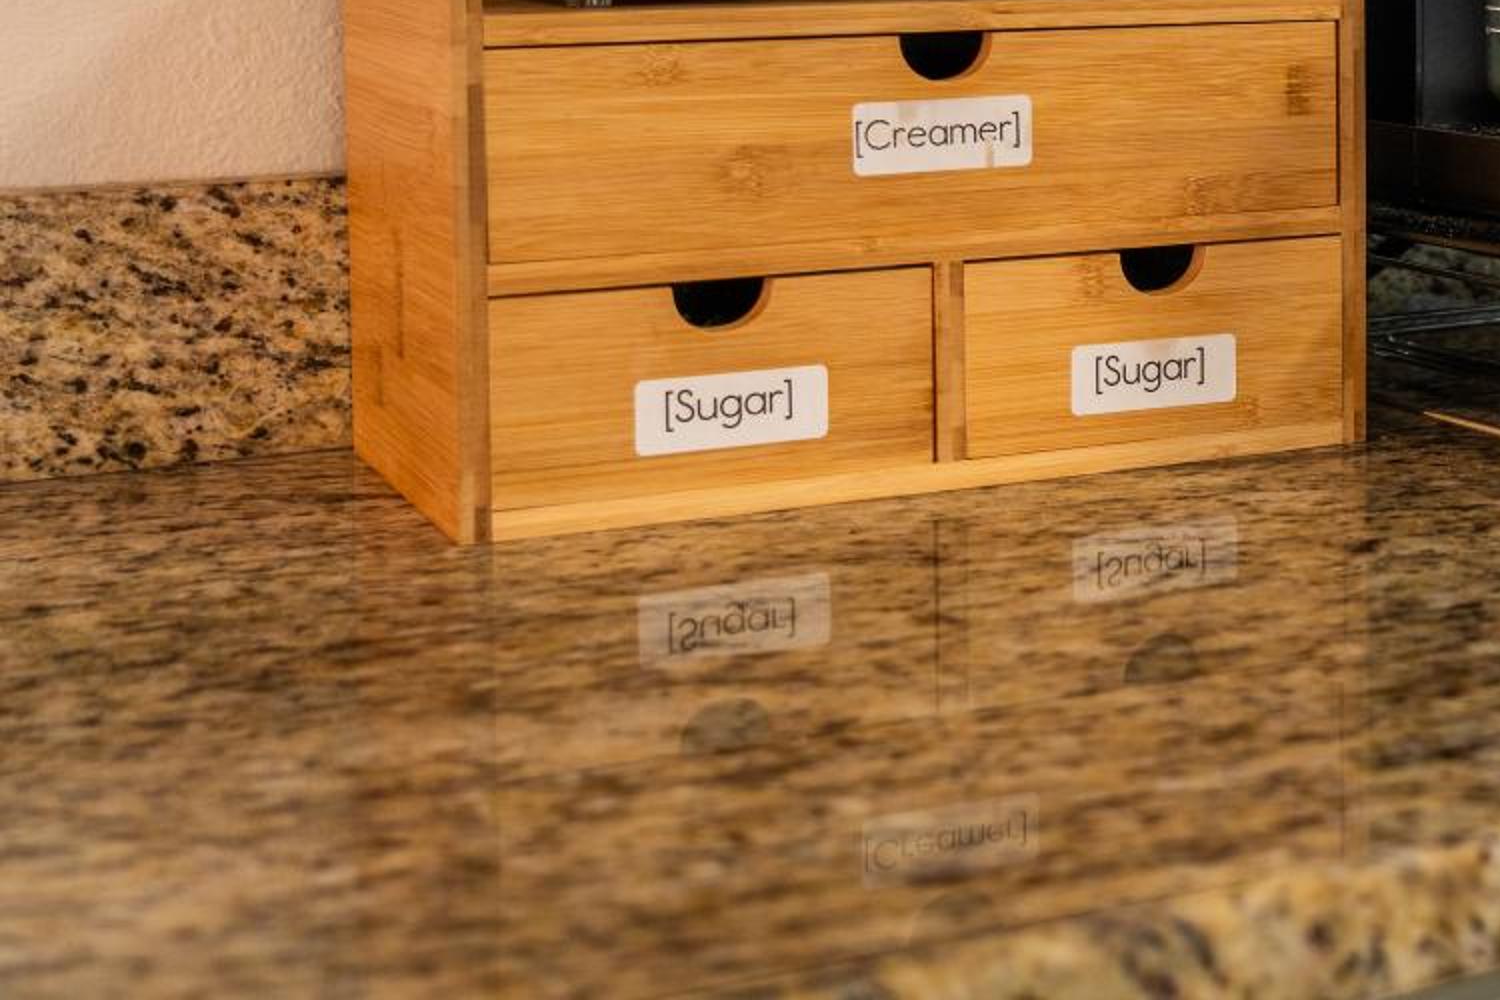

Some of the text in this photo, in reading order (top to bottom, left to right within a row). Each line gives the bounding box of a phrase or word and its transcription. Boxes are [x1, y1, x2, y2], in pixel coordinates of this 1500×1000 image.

[855, 111, 1021, 158] [Creamer]
[1095, 346, 1205, 395] [Sugar]
[665, 378, 793, 432] [Sugar]
